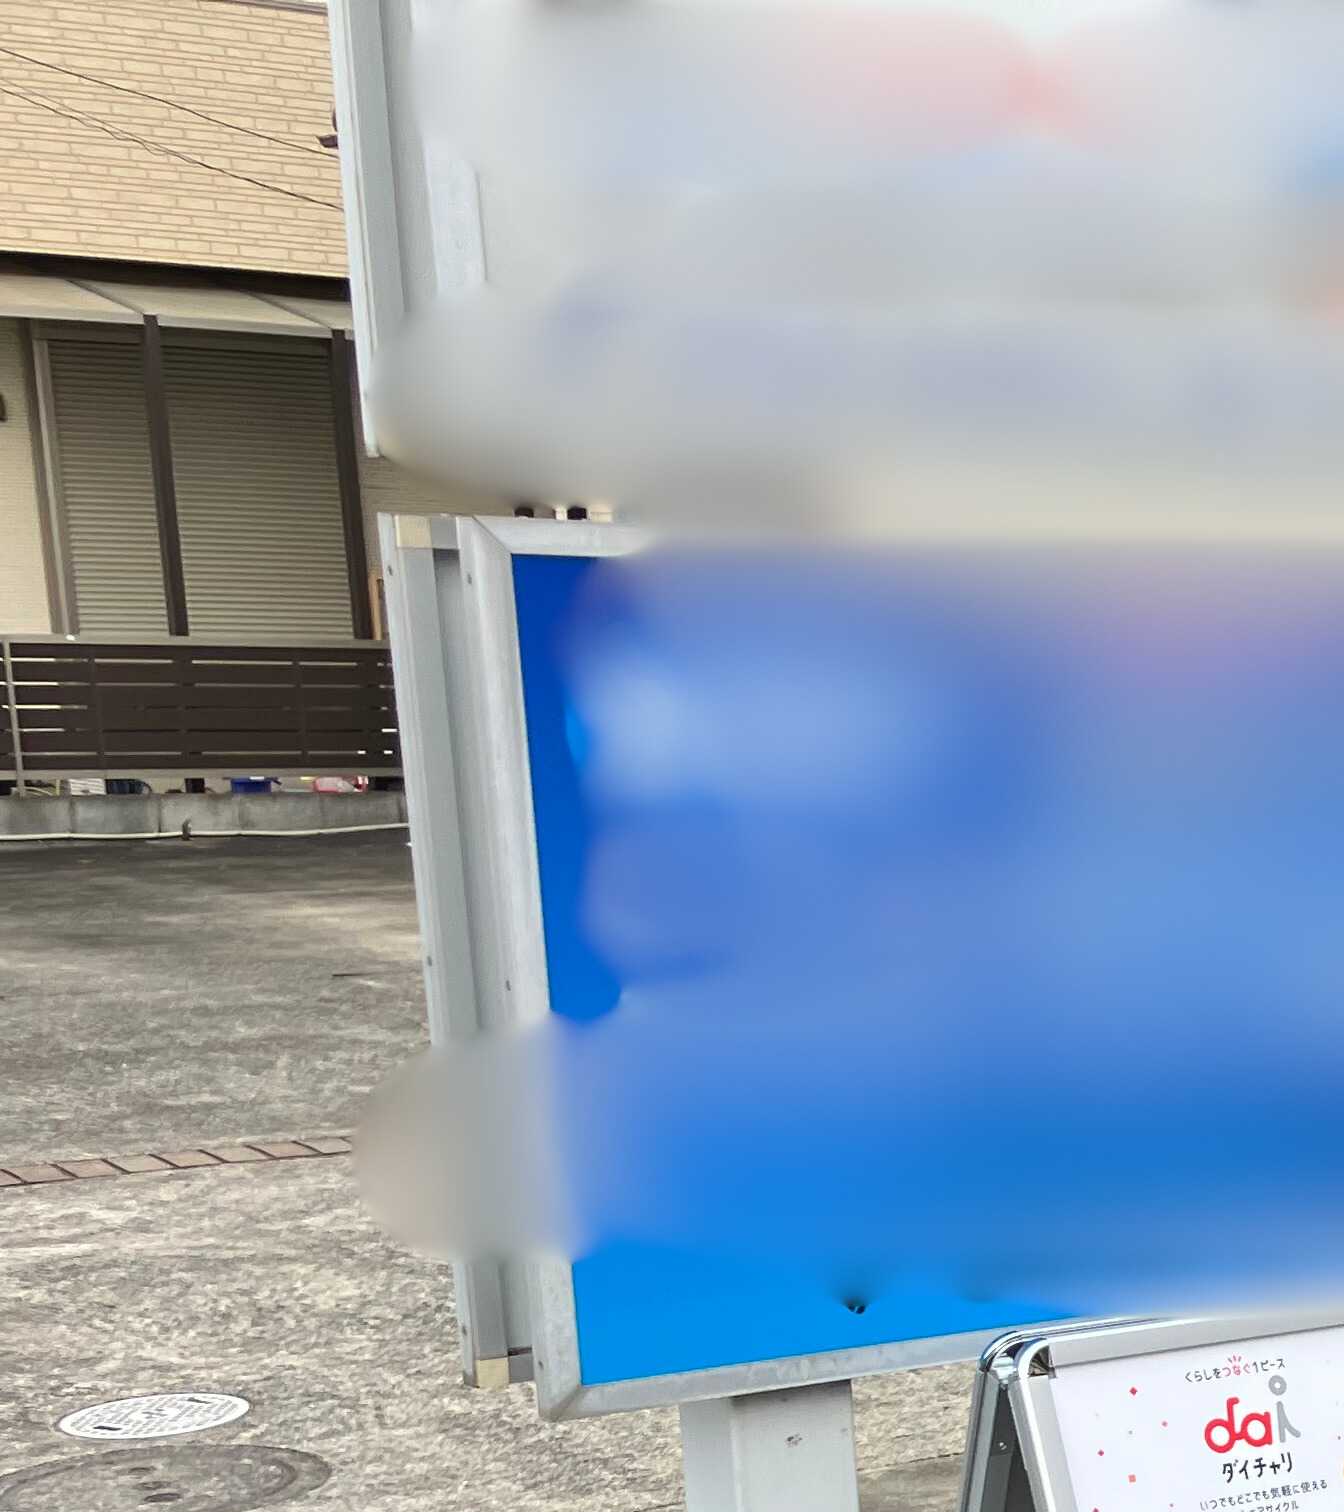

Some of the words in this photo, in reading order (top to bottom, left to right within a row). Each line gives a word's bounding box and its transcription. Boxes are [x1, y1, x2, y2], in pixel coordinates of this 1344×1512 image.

[1183, 1357, 1286, 1383] くらしをつなぐ1ピース
[1219, 1450, 1295, 1484] ダイチャリ
[1198, 1478, 1328, 1512] いつでもどこでも気軽に使える
